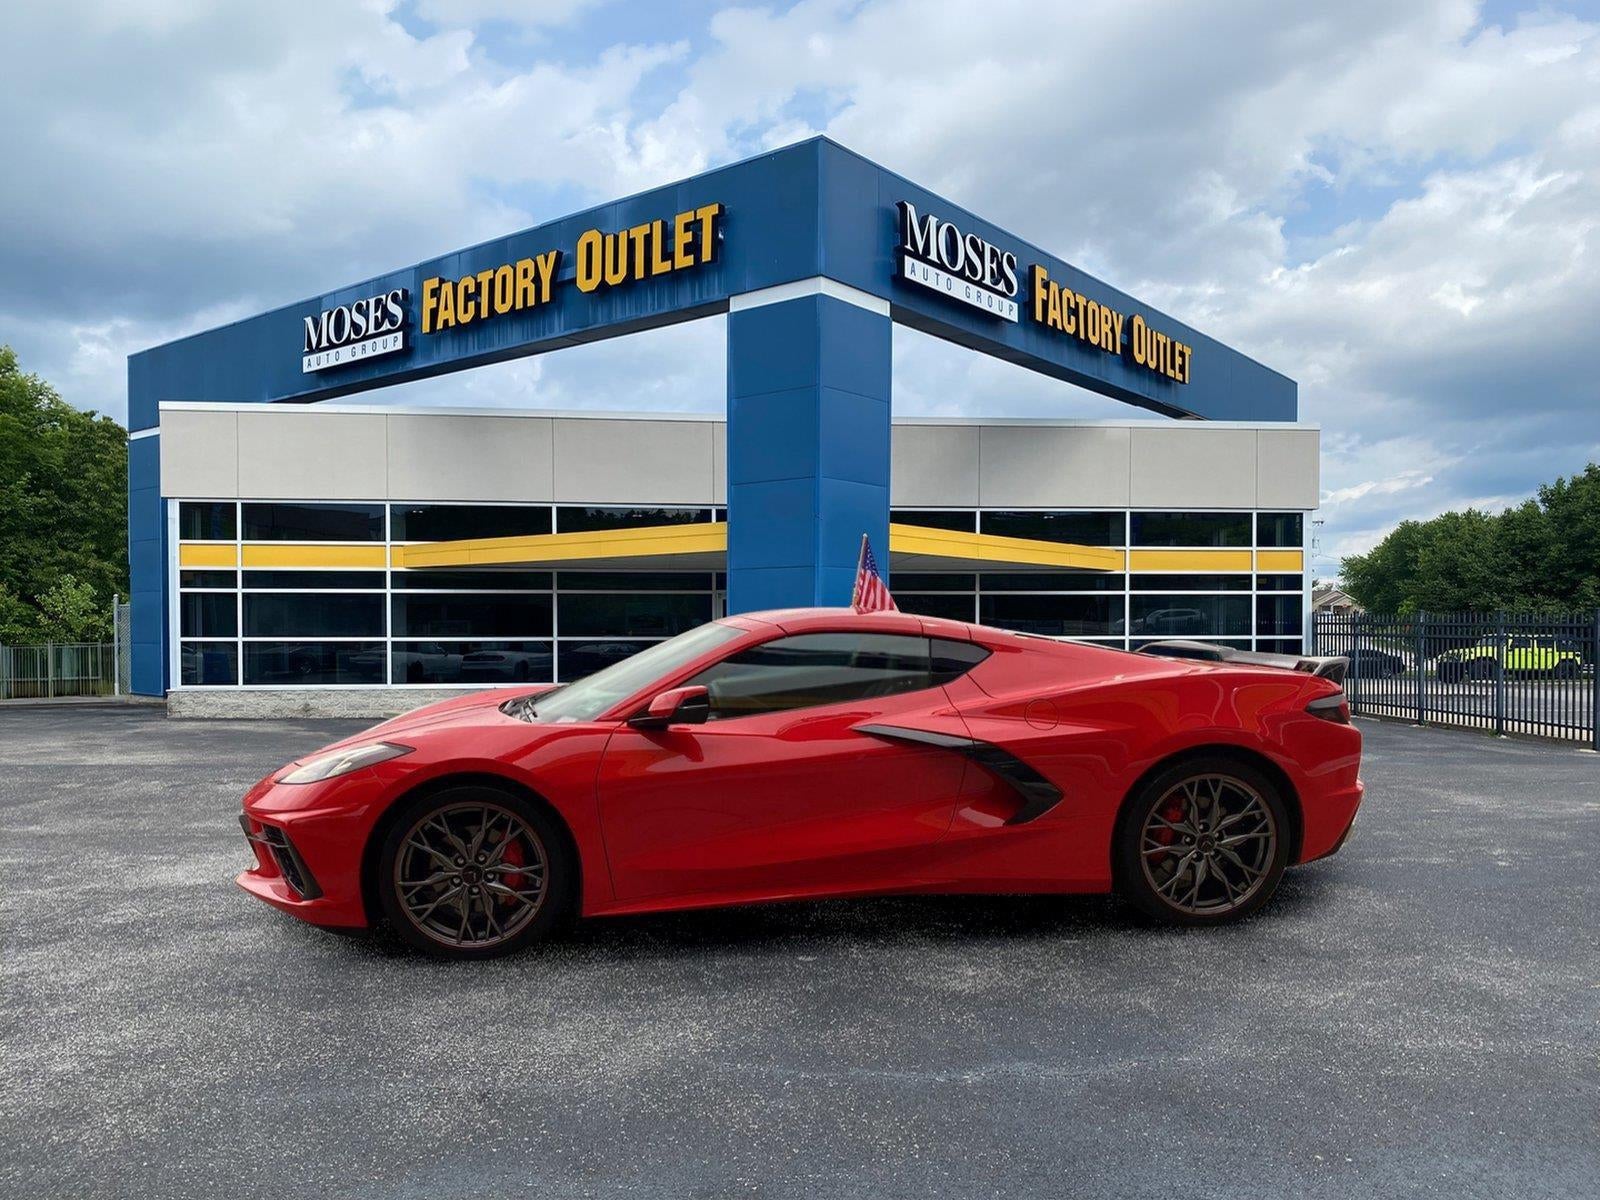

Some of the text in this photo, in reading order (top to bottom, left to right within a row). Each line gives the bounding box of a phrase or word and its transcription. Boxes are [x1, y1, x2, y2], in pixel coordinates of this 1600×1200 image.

[421, 203, 720, 334] FACTORY OUTLET
[904, 201, 1019, 297] MOSES
[303, 289, 403, 352] MOSES
[910, 262, 1015, 317] AUTO GROUP
[1035, 264, 1192, 384] FACTORY OUTLET
[307, 335, 399, 368] AUTO GROUP
